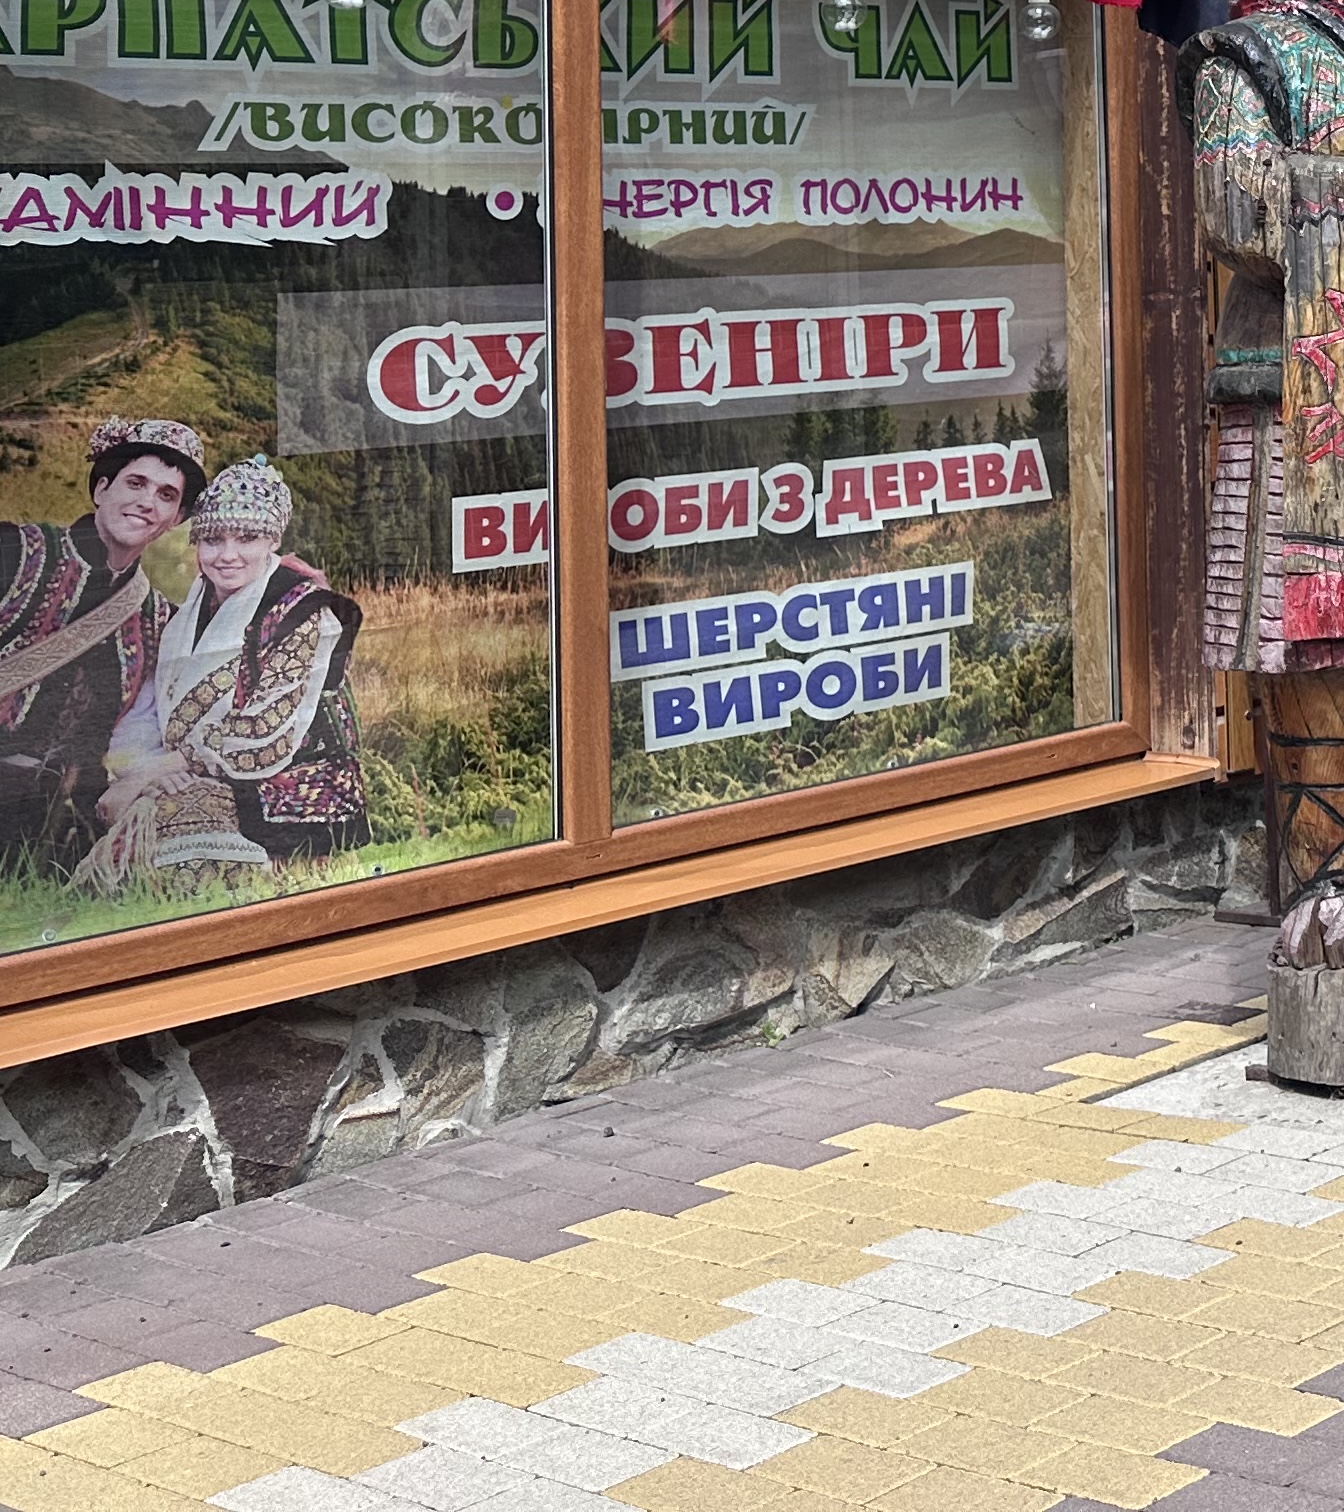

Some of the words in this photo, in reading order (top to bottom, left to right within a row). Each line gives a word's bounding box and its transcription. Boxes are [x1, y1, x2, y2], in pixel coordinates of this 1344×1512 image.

[214, 100, 806, 146] /ВИСОКОІРНИЙ/
[603, 179, 773, 218] НЕРГІЯ
[801, 177, 1024, 217] ПОЛОНИН
[464, 479, 749, 560] ВИОБИ
[771, 473, 805, 523] З
[825, 449, 1044, 525] ДЕРЕВА
[618, 572, 967, 669] ШЕРСТЯНІ
[653, 644, 943, 739] ВИРОБИ
